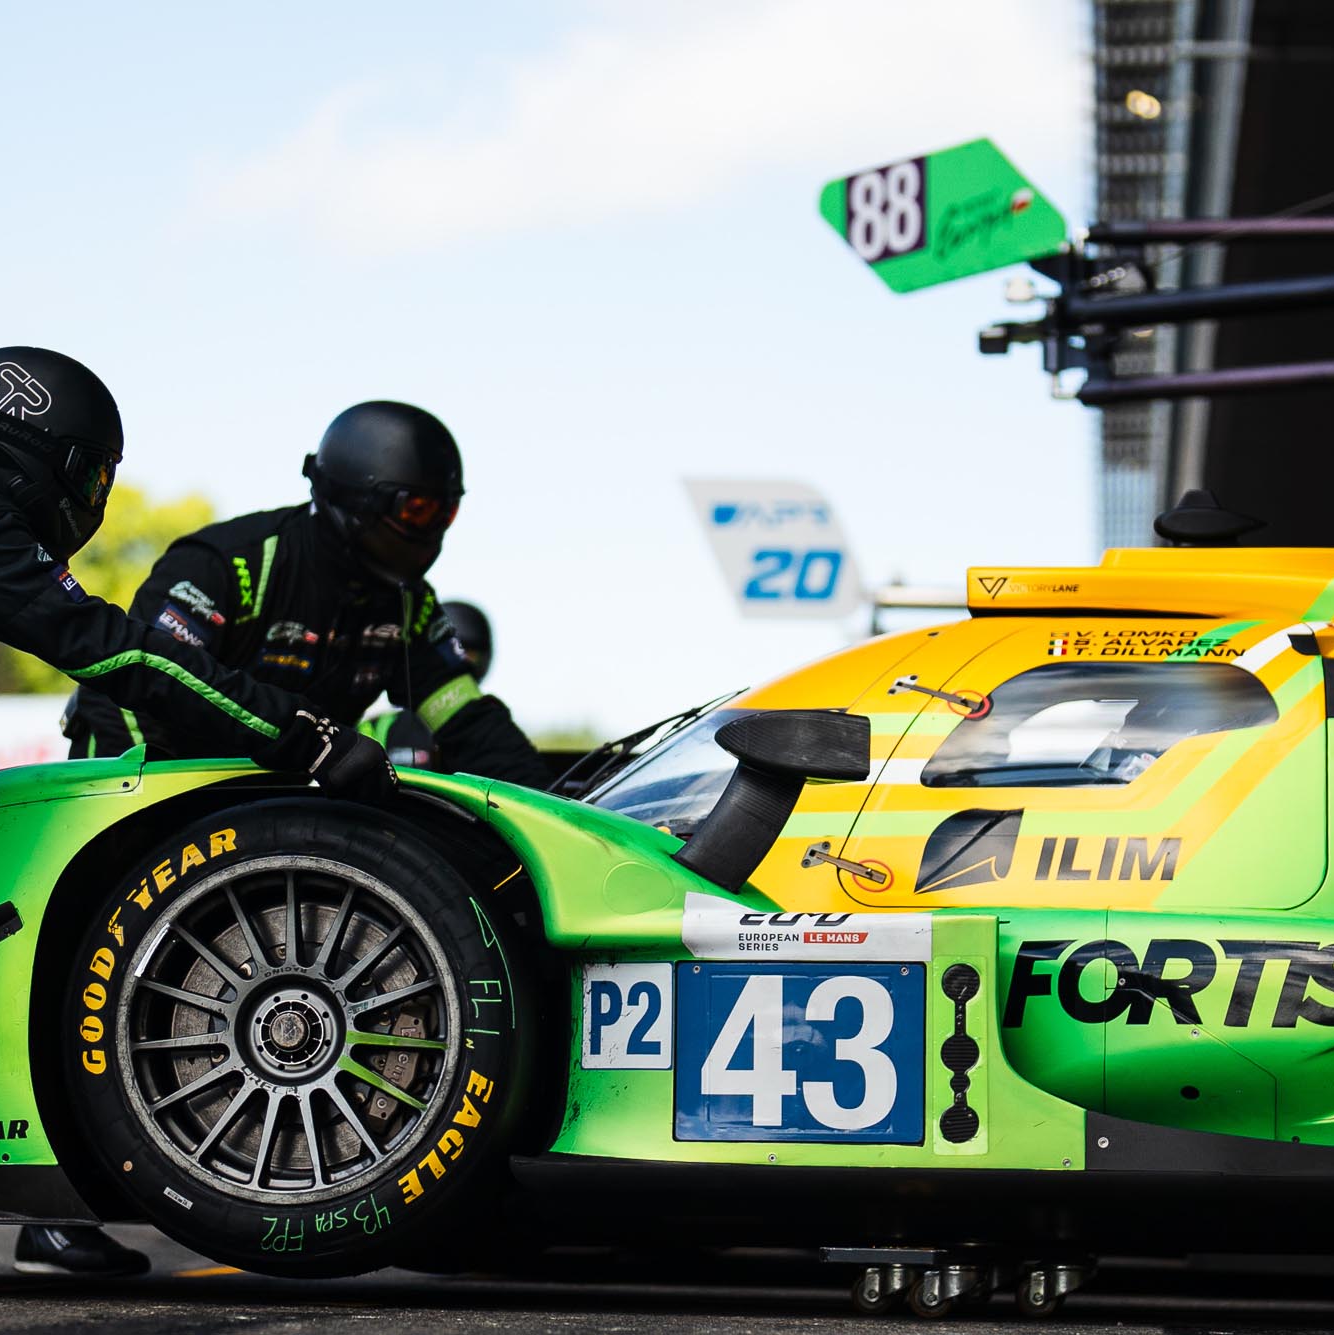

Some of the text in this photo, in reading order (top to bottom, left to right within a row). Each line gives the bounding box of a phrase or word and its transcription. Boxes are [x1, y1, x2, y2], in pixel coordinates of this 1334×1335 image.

[849, 162, 923, 262] 88
[745, 550, 842, 600] 20
[1100, 647, 1246, 657] DILLMANN
[1105, 638, 1230, 647] ALVAREZ
[1034, 836, 1183, 881] ILIM
[738, 932, 860, 943] EUROPEAN LE MANS
[738, 942, 780, 951] SERIES
[588, 980, 662, 1056] P2
[700, 974, 898, 1131] 43
[397, 1069, 495, 1205] EAGLE
[315, 1206, 348, 1233] SPA
[352, 1193, 392, 1235] 43
